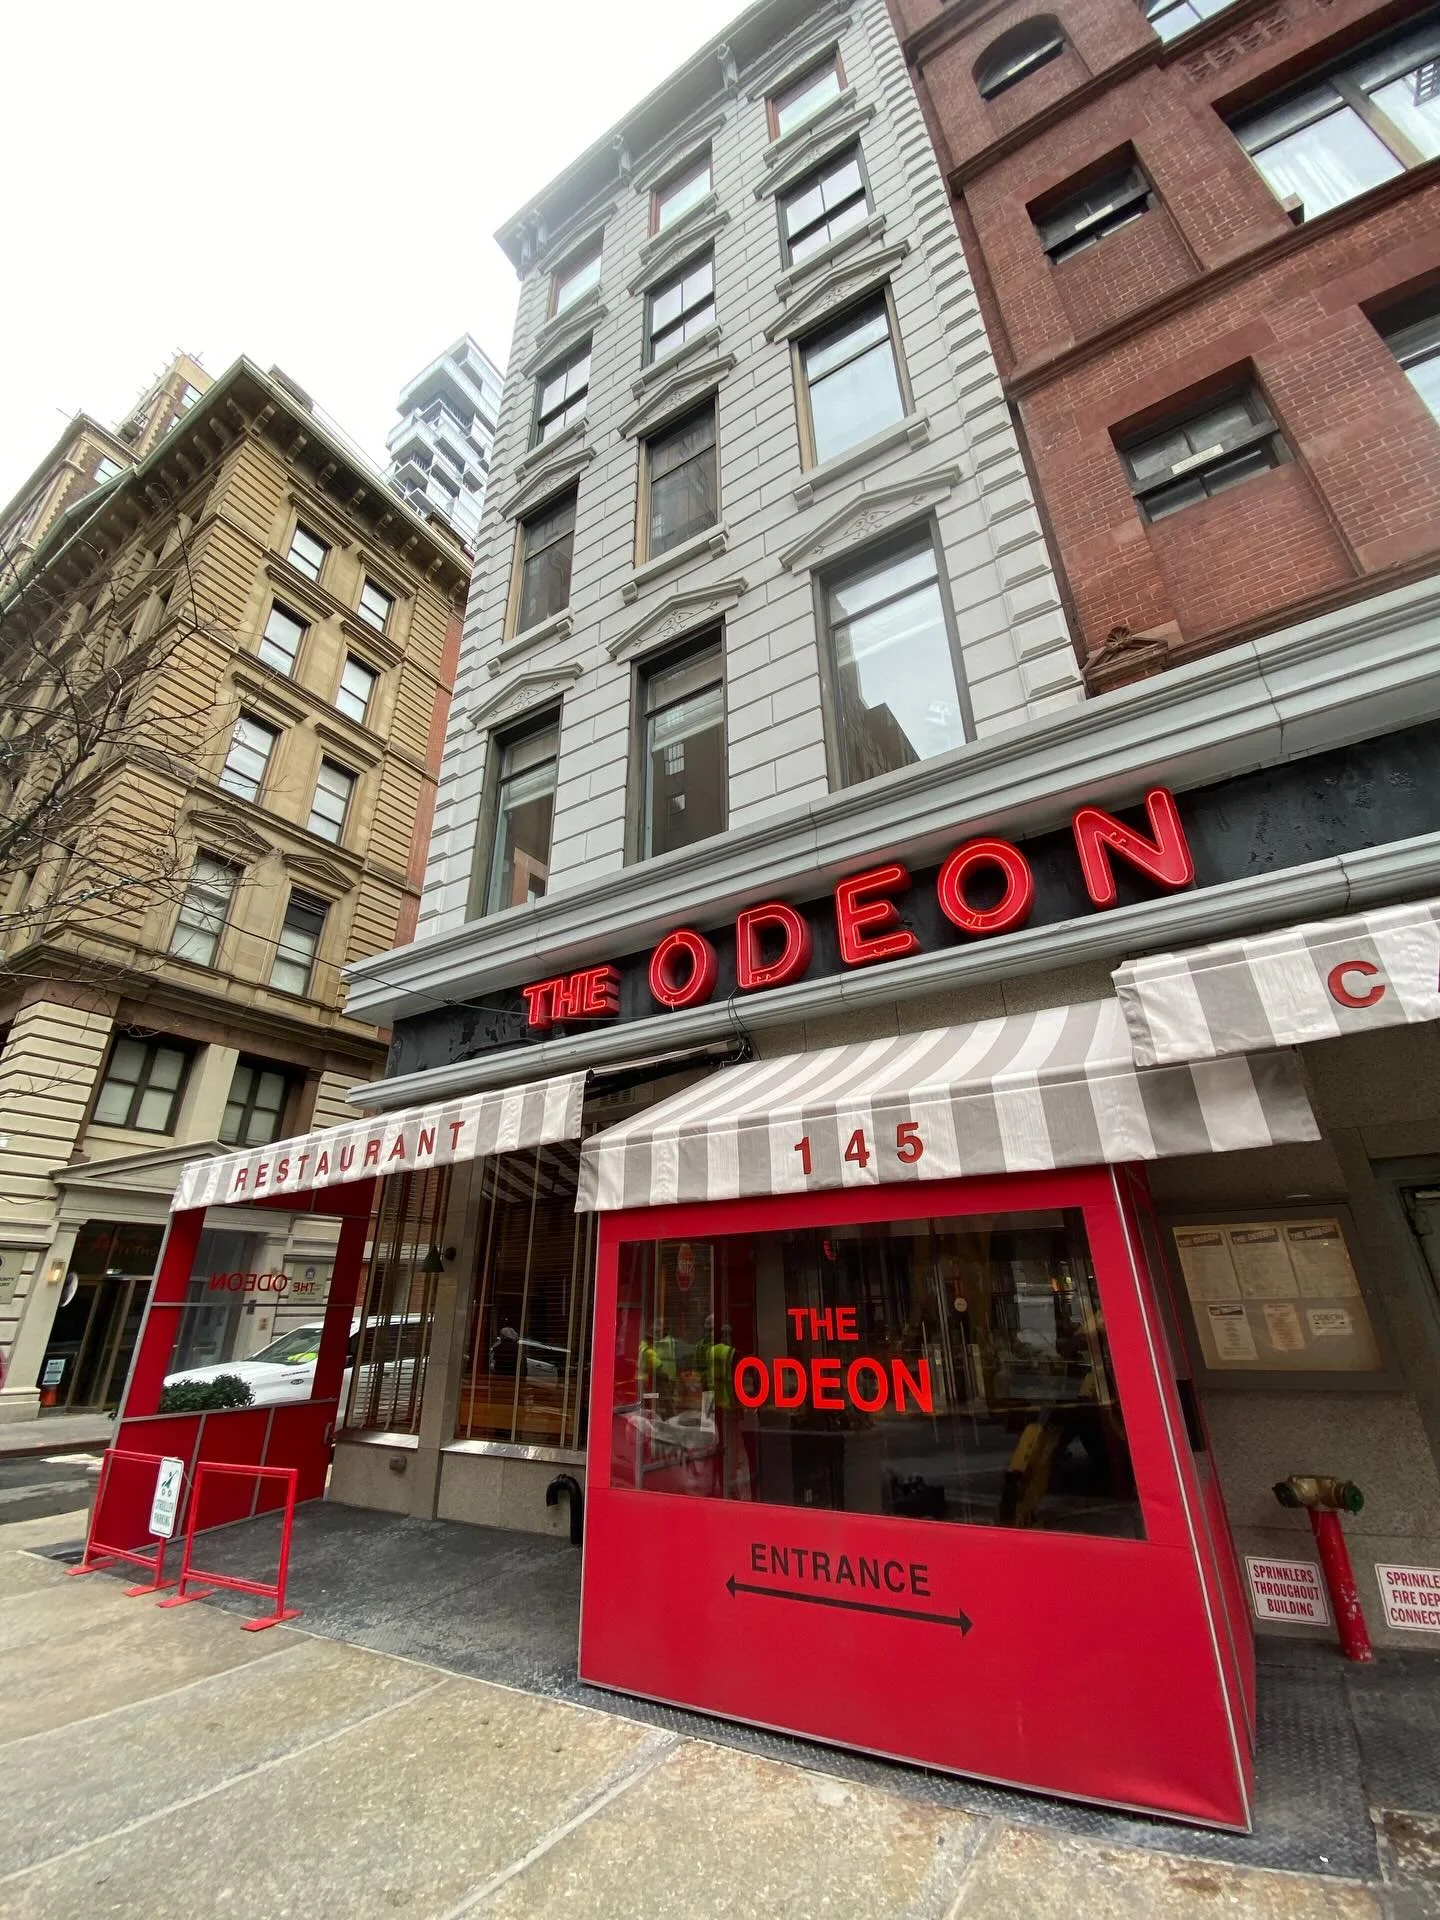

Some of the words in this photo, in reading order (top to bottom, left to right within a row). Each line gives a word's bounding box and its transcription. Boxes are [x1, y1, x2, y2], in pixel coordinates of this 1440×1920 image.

[523, 964, 621, 1030] THE
[647, 786, 1197, 1011] ODEON
[234, 1120, 466, 1194] RESTAURANT
[794, 1121, 924, 1175] 145
[787, 1307, 860, 1341] THE
[733, 1356, 935, 1413] ODEON
[751, 1543, 931, 1597] ENTRANCE
[1253, 1564, 1314, 1583] SPRINKLERS
[1254, 1581, 1319, 1600] THROUGHOUT
[1267, 1598, 1314, 1616] BUILDING
[1392, 1589, 1418, 1606] FIRE
